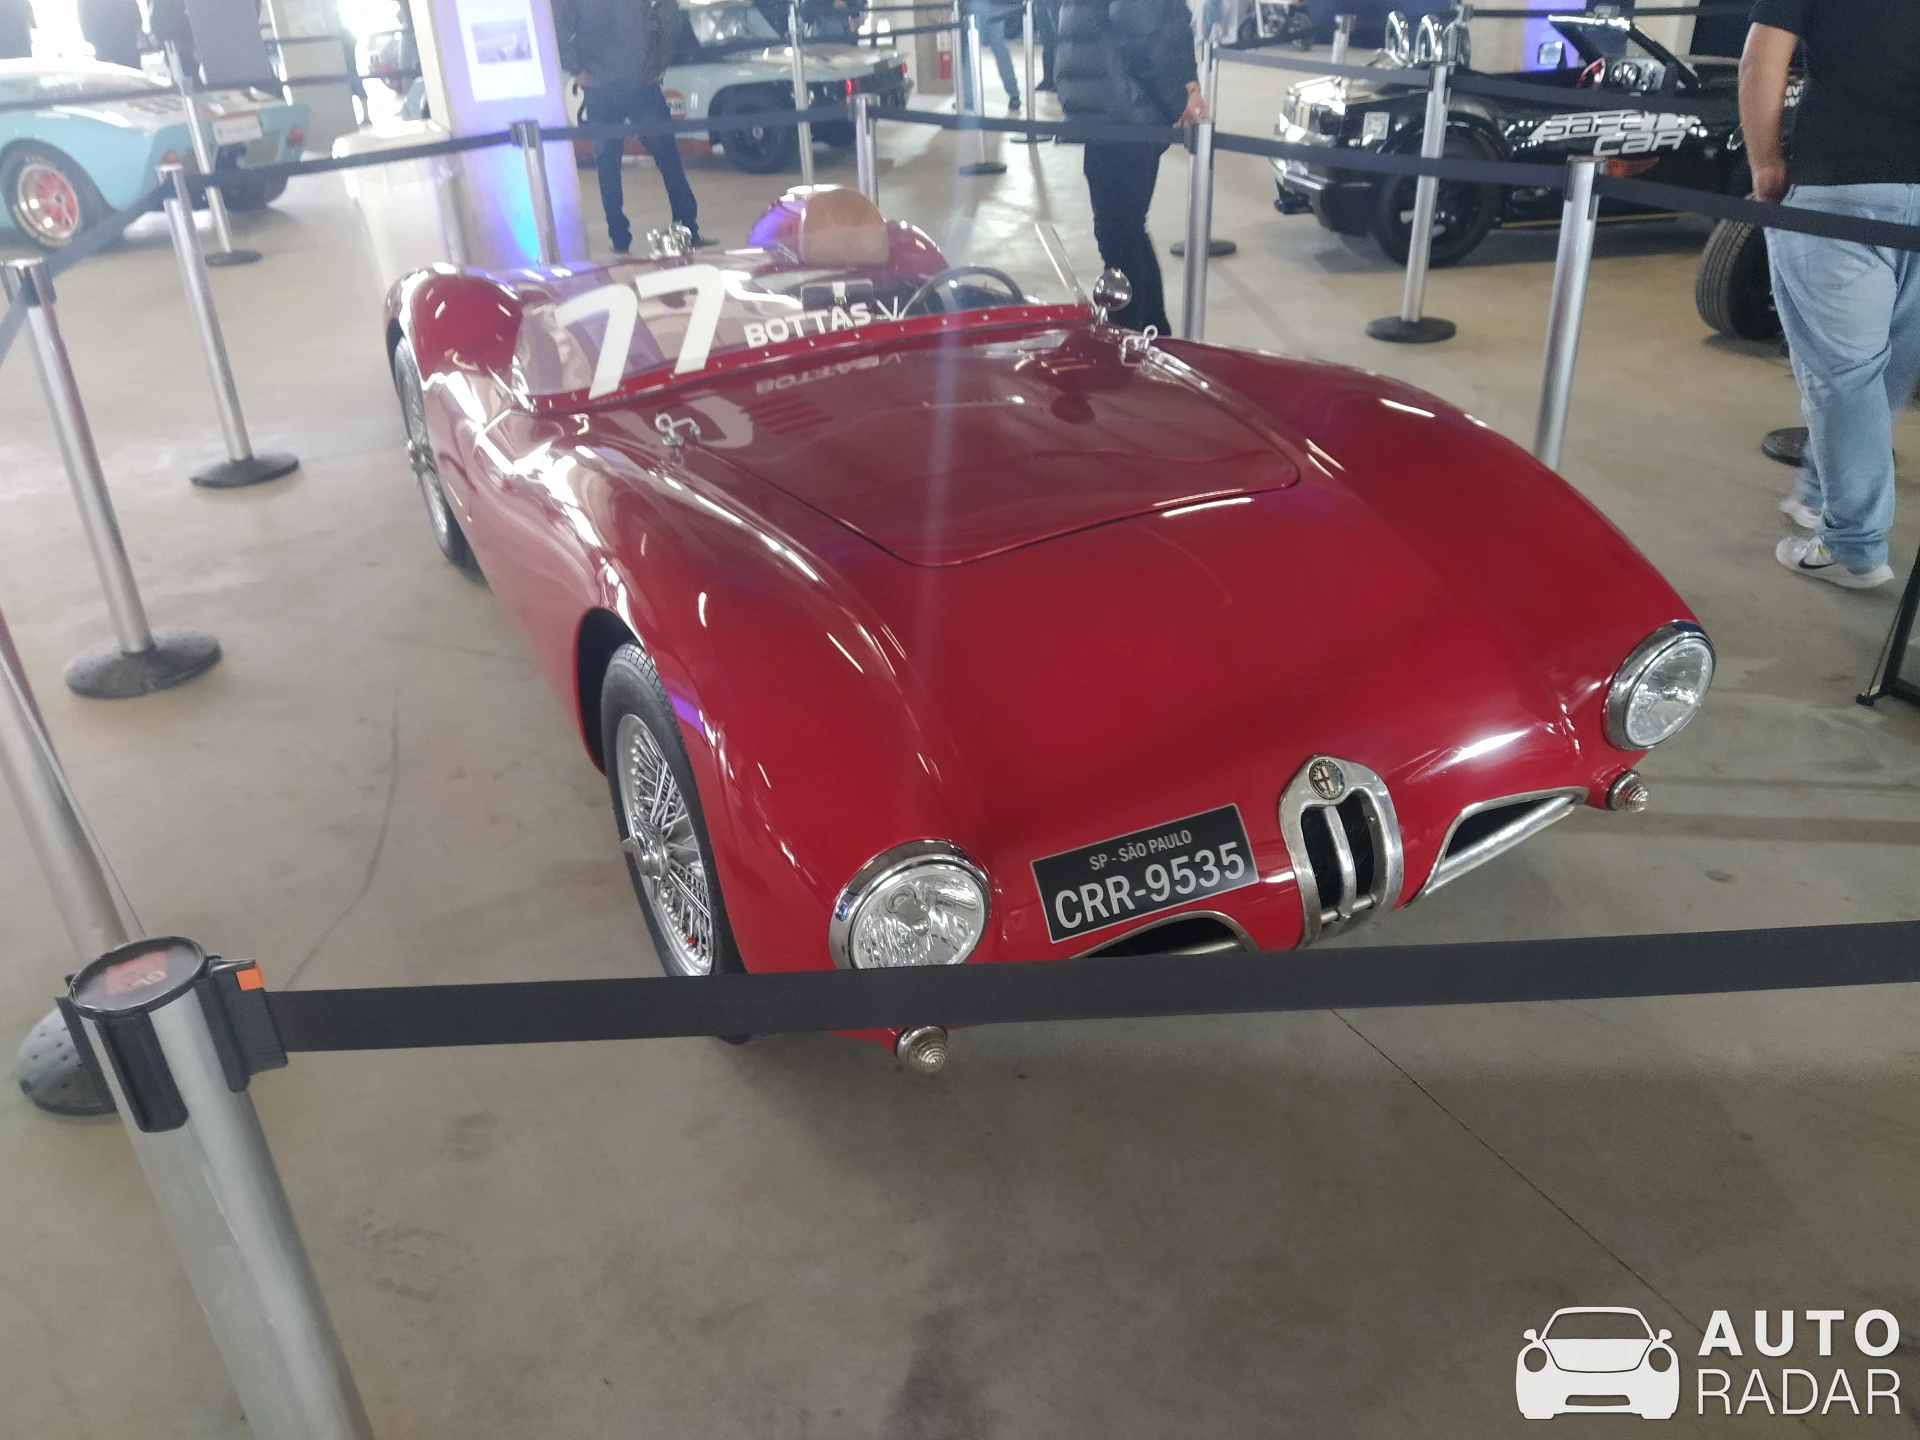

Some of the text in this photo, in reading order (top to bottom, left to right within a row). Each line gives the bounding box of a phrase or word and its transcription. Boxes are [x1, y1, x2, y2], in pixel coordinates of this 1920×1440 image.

[554, 264, 726, 400] 77
[743, 301, 872, 349] BOTTAS
[1089, 853, 1107, 871] SP
[1118, 842, 1147, 862] SÃO
[1149, 829, 1193, 854] PAULO
[1055, 841, 1245, 929] CRR-9535
